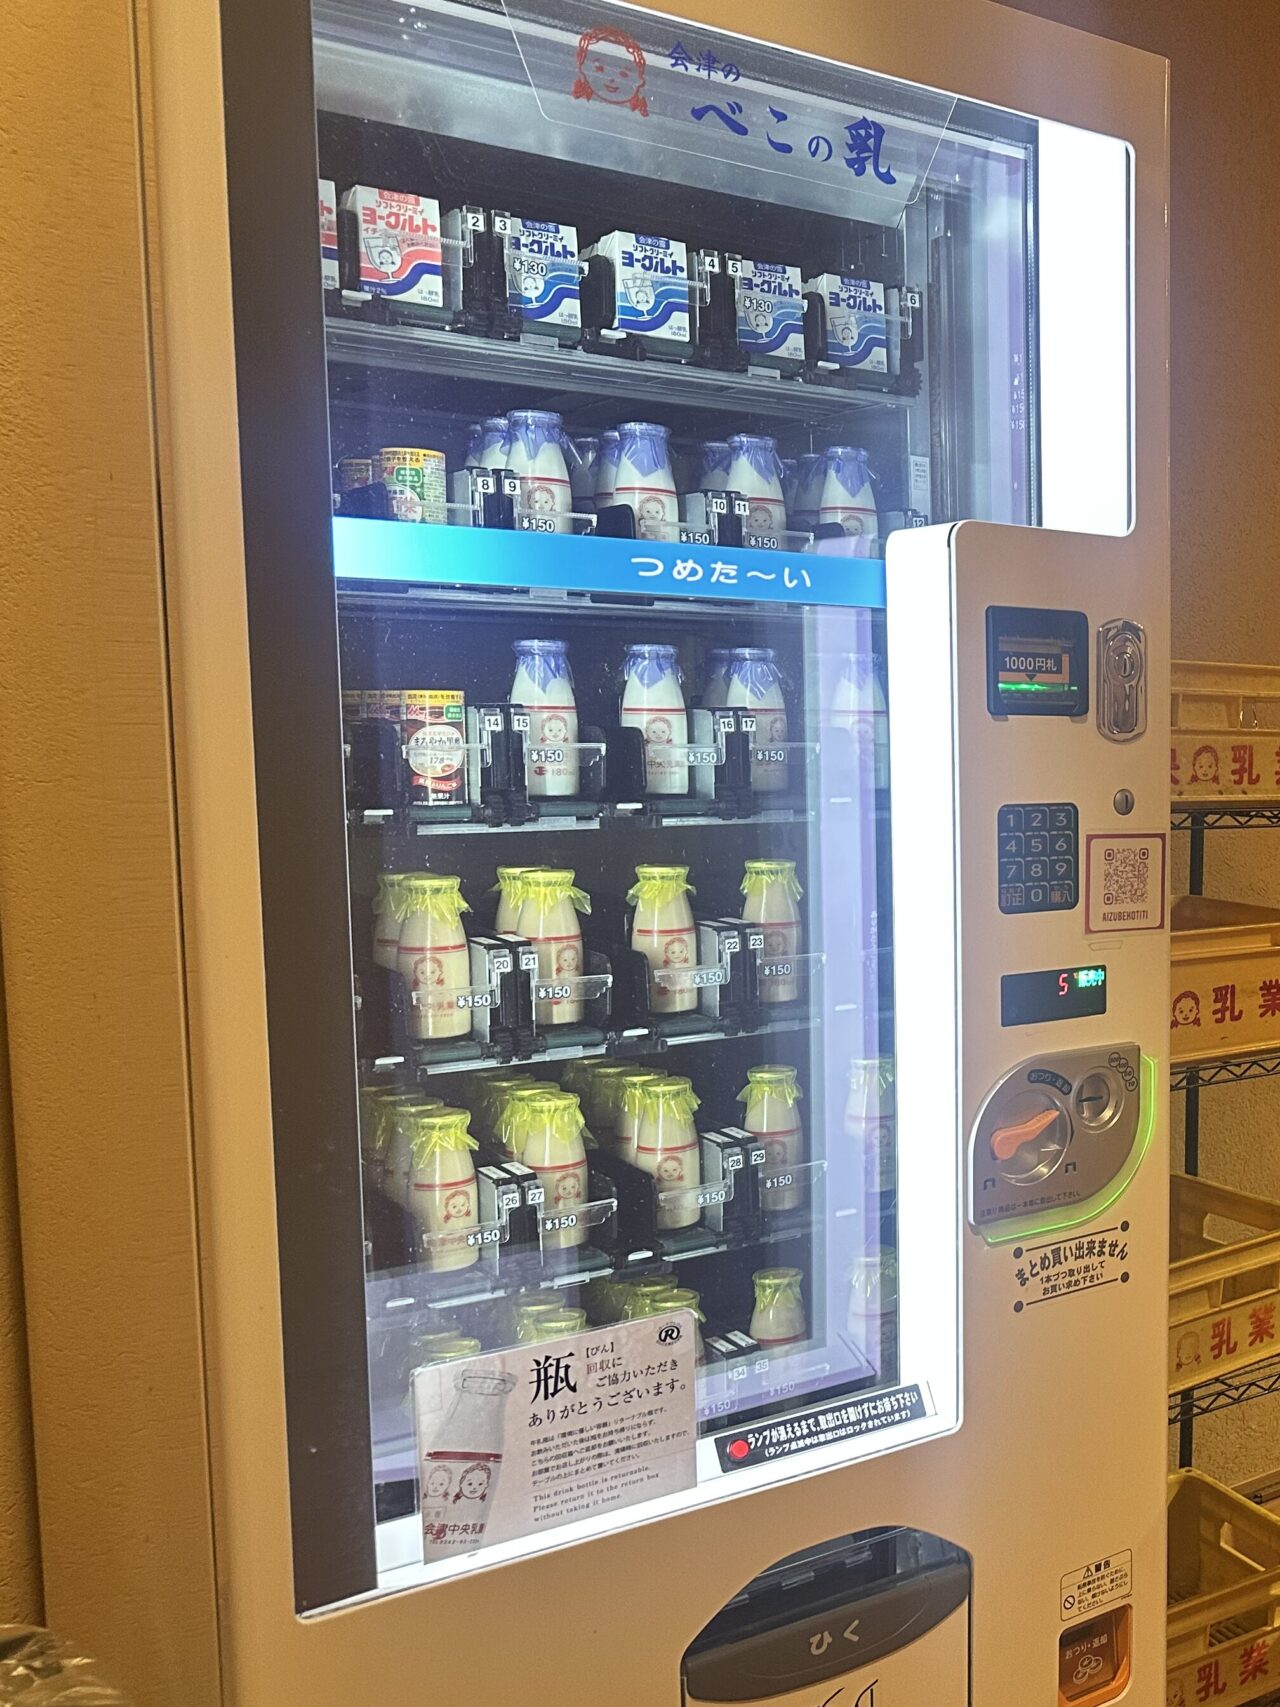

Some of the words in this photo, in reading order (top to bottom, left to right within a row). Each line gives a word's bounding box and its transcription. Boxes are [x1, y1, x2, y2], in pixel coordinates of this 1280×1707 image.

[666, 41, 740, 83] 会津の
[690, 101, 897, 185] べこの乳
[362, 206, 437, 235] ヨーグルト
[472, 216, 480, 227] 2
[499, 220, 507, 231] 3
[511, 236, 576, 259] ヨーグルト
[513, 257, 547, 276] ¥130
[621, 250, 685, 276] ヨーグルト
[708, 259, 715, 269] 4
[731, 262, 739, 273] 5
[741, 277, 800, 297] ヨーグルト
[744, 296, 772, 313] ¥130
[829, 291, 883, 313] ヨーグルト
[909, 294, 917, 305] 6
[482, 479, 490, 490] 8
[508, 481, 516, 492] 9
[713, 501, 725, 511] 10
[736, 503, 747, 512] 11
[521, 516, 555, 532] ¥150
[680, 532, 710, 545] ¥150
[750, 536, 777, 549] ¥150
[1004, 656, 1057, 671] 1000円札
[487, 718, 499, 728] 14
[516, 718, 528, 728] 15
[721, 720, 733, 730] 16
[743, 719, 755, 729] 17
[531, 750, 563, 763] ¥150
[688, 752, 717, 763] ¥150
[757, 750, 784, 761] ¥150
[1007, 814, 1014, 827] 1
[1031, 813, 1042, 826] 2
[1055, 813, 1067, 826] 3
[1005, 840, 1017, 853] 4
[1031, 838, 1042, 852] 5
[1055, 838, 1067, 851] 6
[1006, 865, 1017, 878] 7
[1031, 864, 1042, 877] 8
[1055, 863, 1067, 876] 9
[1031, 888, 1042, 902] 0
[1102, 911, 1148, 922] AIZUBEKOTITI
[726, 941, 738, 950] 22
[751, 937, 763, 947] 23
[495, 960, 509, 970] 20
[524, 957, 536, 967] 21
[764, 964, 791, 975] ¥150
[694, 971, 722, 984] ¥150
[1059, 973, 1069, 995] 5
[538, 986, 571, 998] ¥150
[457, 995, 491, 1008] ¥150
[730, 1158, 742, 1168] 28
[753, 1152, 765, 1162] 29
[765, 1174, 792, 1188] ¥150
[505, 1195, 518, 1206] 26
[530, 1192, 542, 1201] 27
[698, 1190, 726, 1205] ¥150
[545, 1214, 577, 1230] ¥150
[467, 1229, 500, 1246] ¥150
[1015, 1238, 1128, 1287] まとめ買い出来ません
[1042, 1272, 1103, 1296] お買い求め下さい
[1210, 1301, 1277, 1361] 乳業
[586, 1356, 622, 1374] 回収に
[757, 1361, 768, 1371] 35
[529, 1352, 577, 1404] 瓶
[596, 1358, 678, 1388] ご協力いただき
[735, 1368, 746, 1378] 34
[769, 1382, 796, 1397] ¥150
[528, 1378, 686, 1427] ありがとうございます。
[703, 1399, 731, 1416] ¥150
[533, 1493, 551, 1502] This
[553, 1486, 574, 1497] drink
[809, 1619, 860, 1656] ひく
[1196, 1639, 1270, 1700] 乳業
